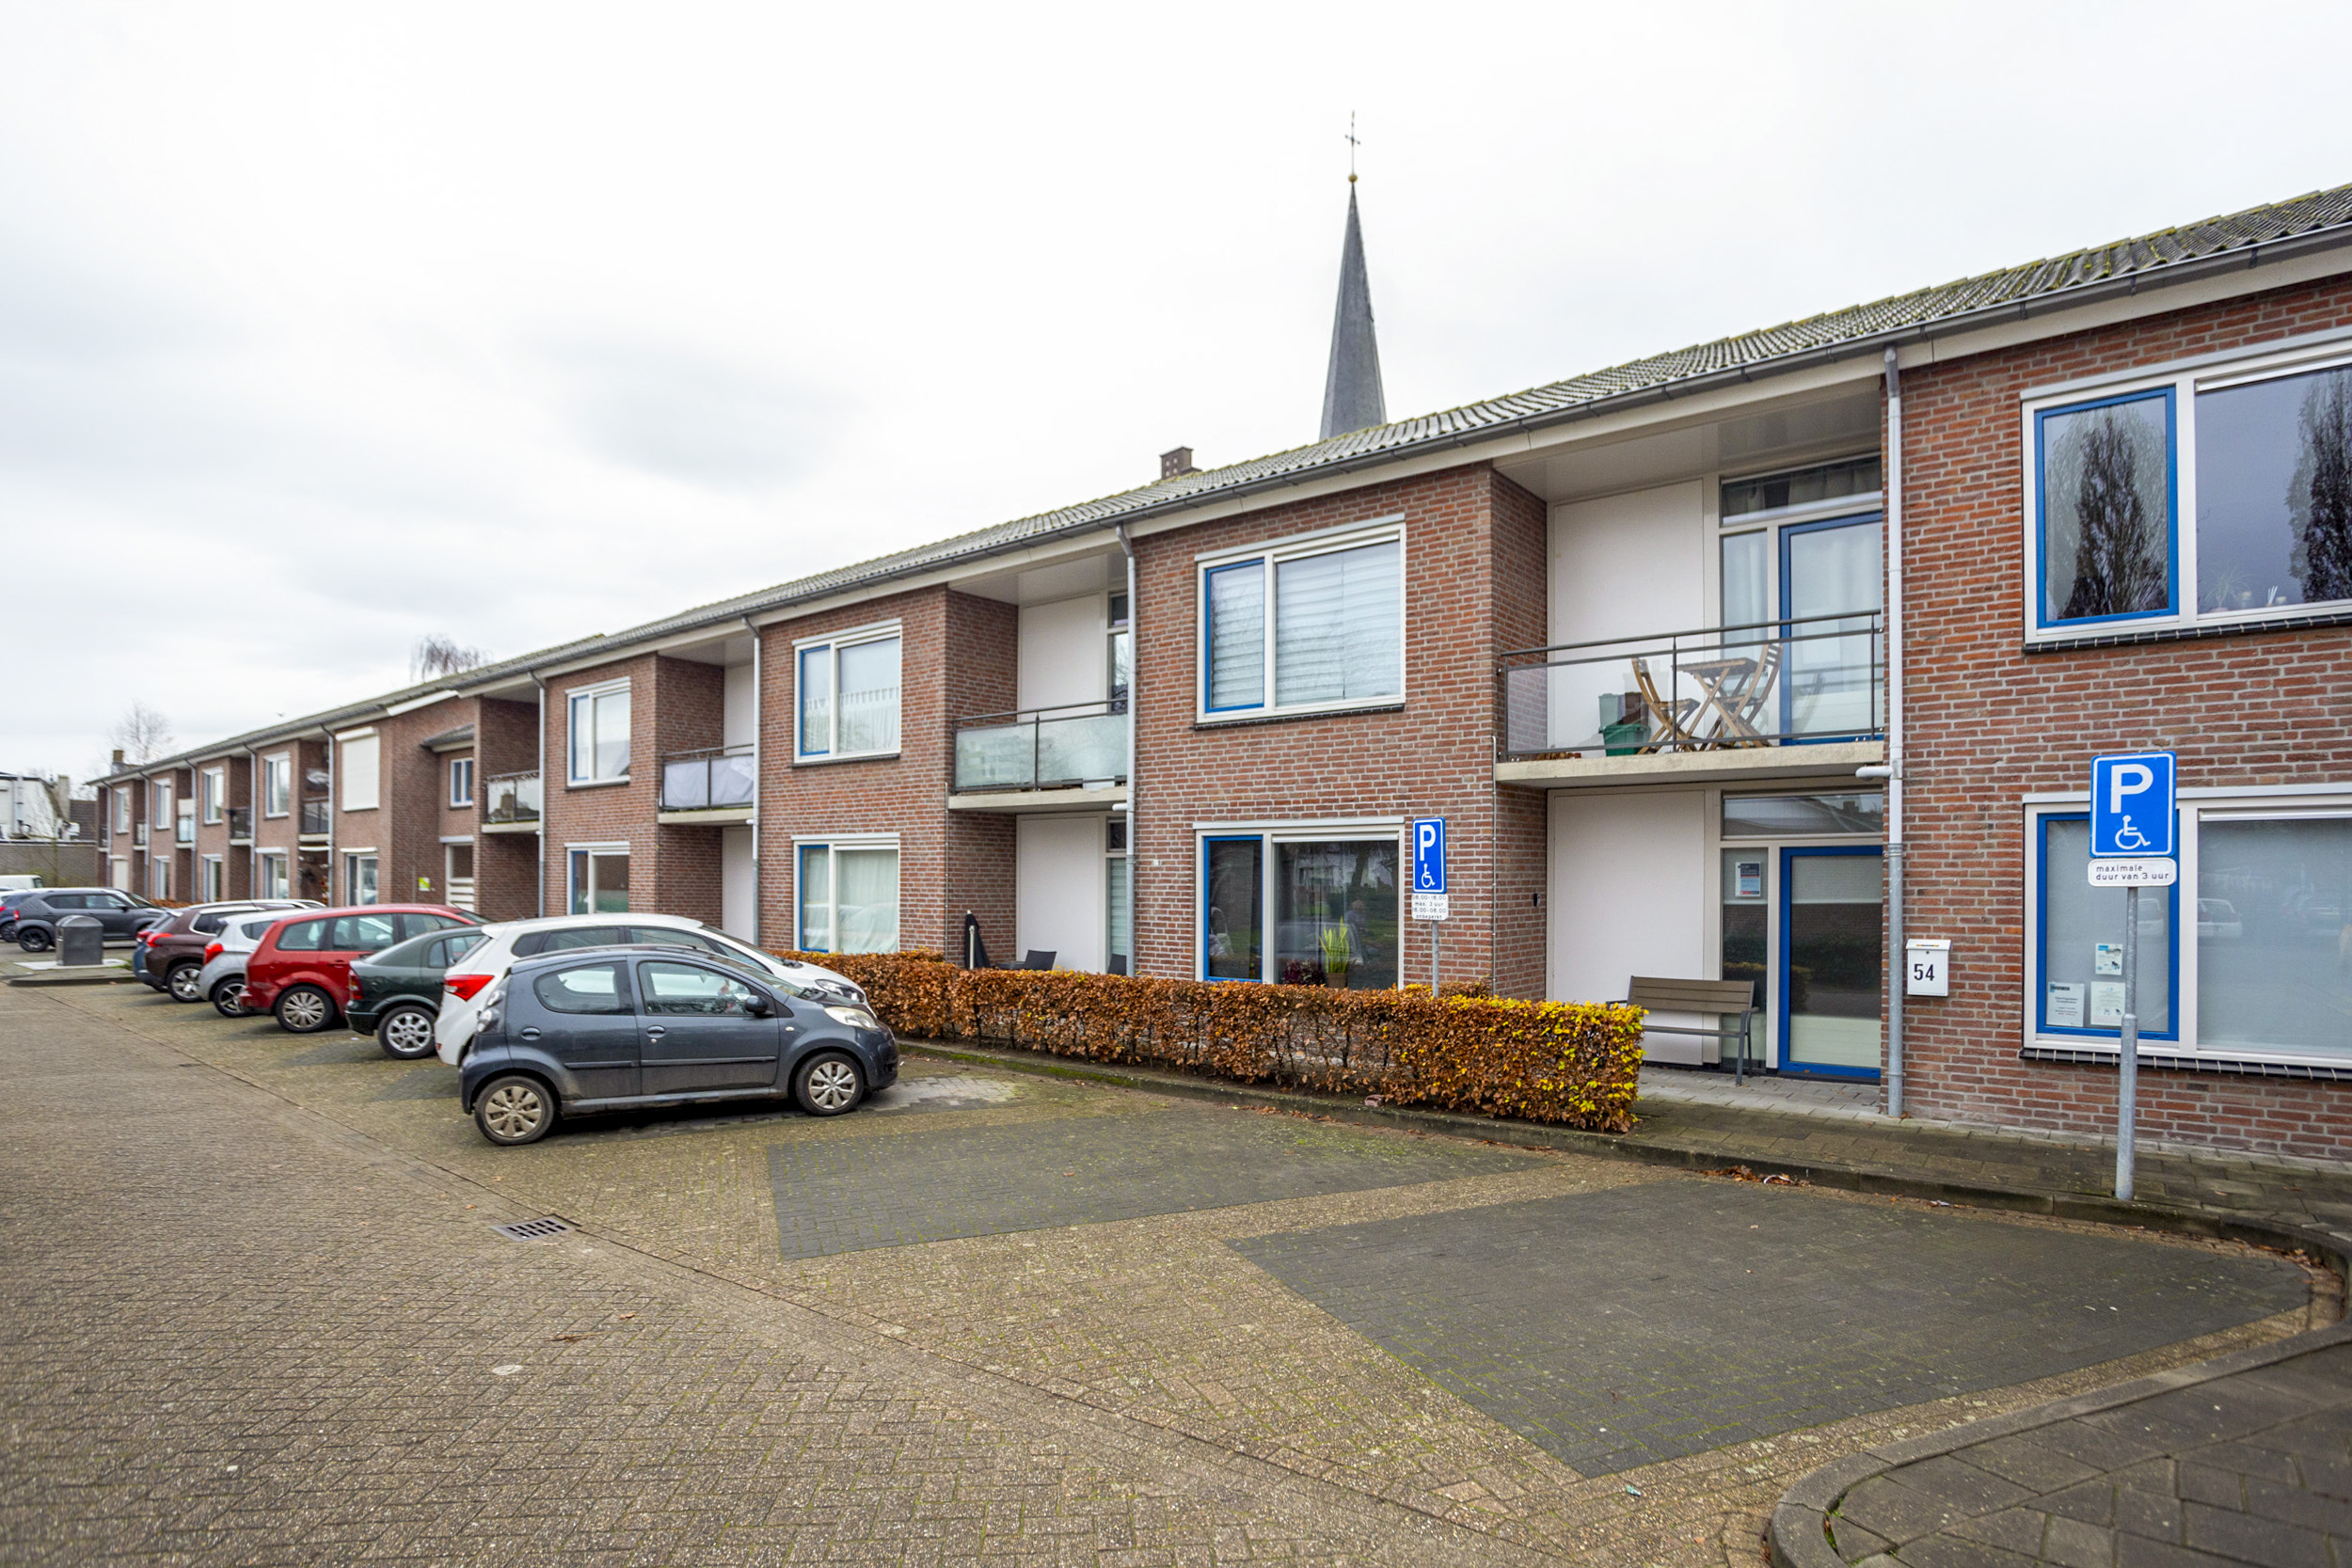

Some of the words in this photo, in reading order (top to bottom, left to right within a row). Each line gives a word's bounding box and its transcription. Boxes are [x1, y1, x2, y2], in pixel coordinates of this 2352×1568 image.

[2110, 764, 2153, 814] P
[1420, 824, 1436, 861] P
[1914, 963, 1935, 981] 54
